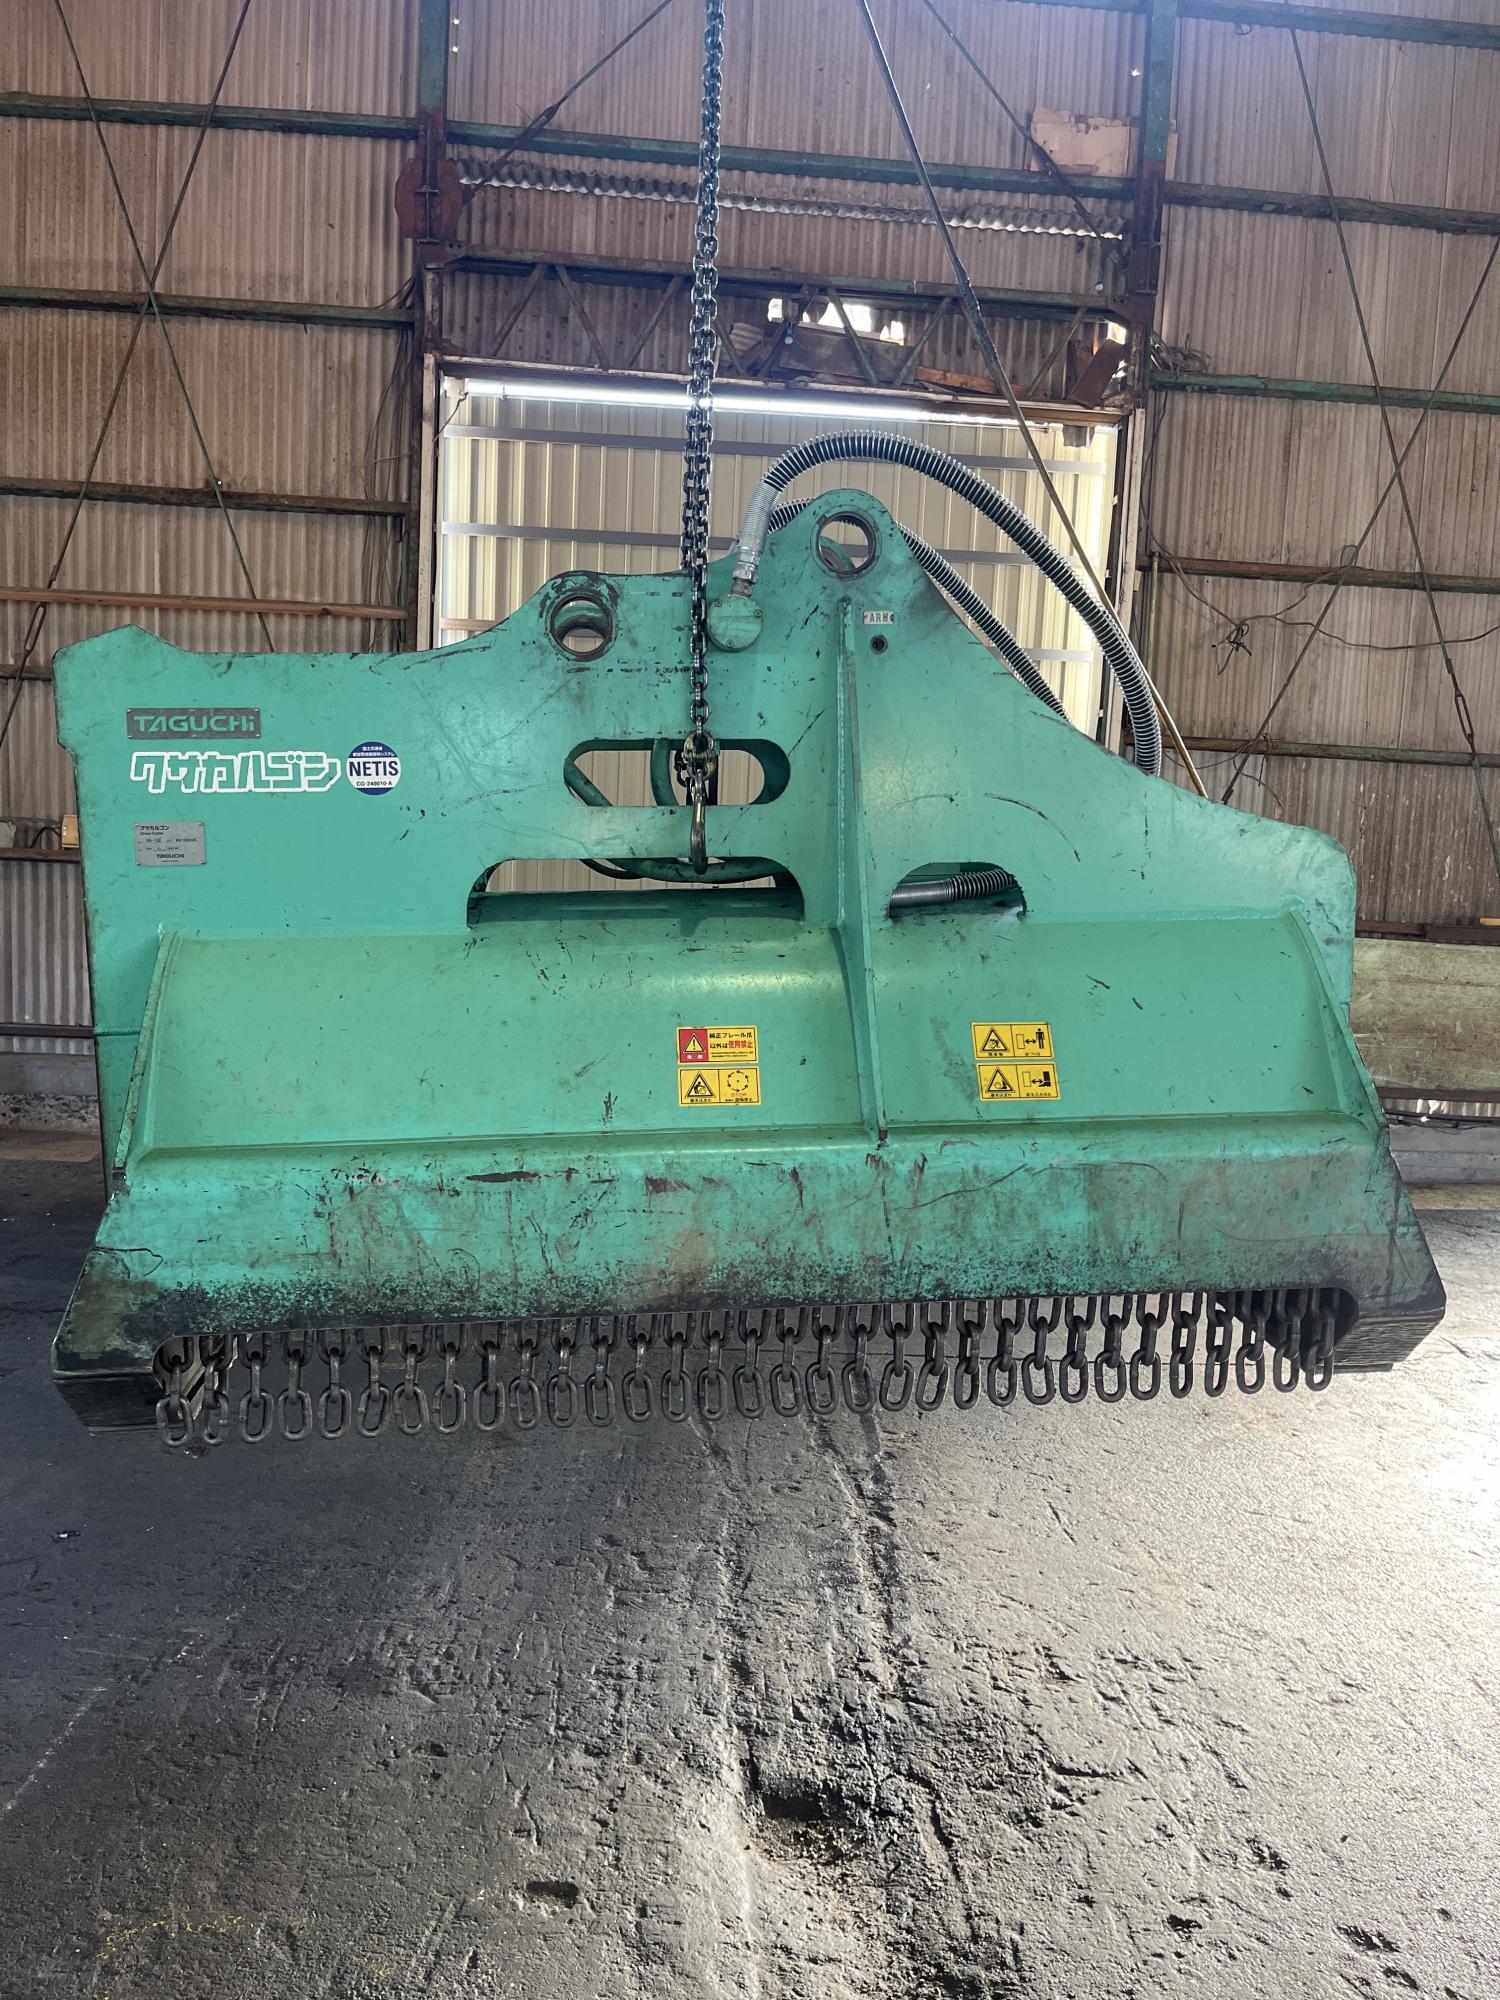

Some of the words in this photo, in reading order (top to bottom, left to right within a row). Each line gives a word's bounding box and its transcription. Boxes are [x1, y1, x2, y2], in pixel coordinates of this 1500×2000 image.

[870, 612, 889, 622] ARM
[129, 750, 342, 795] クサカルゴン
[349, 760, 399, 777] NETIS
